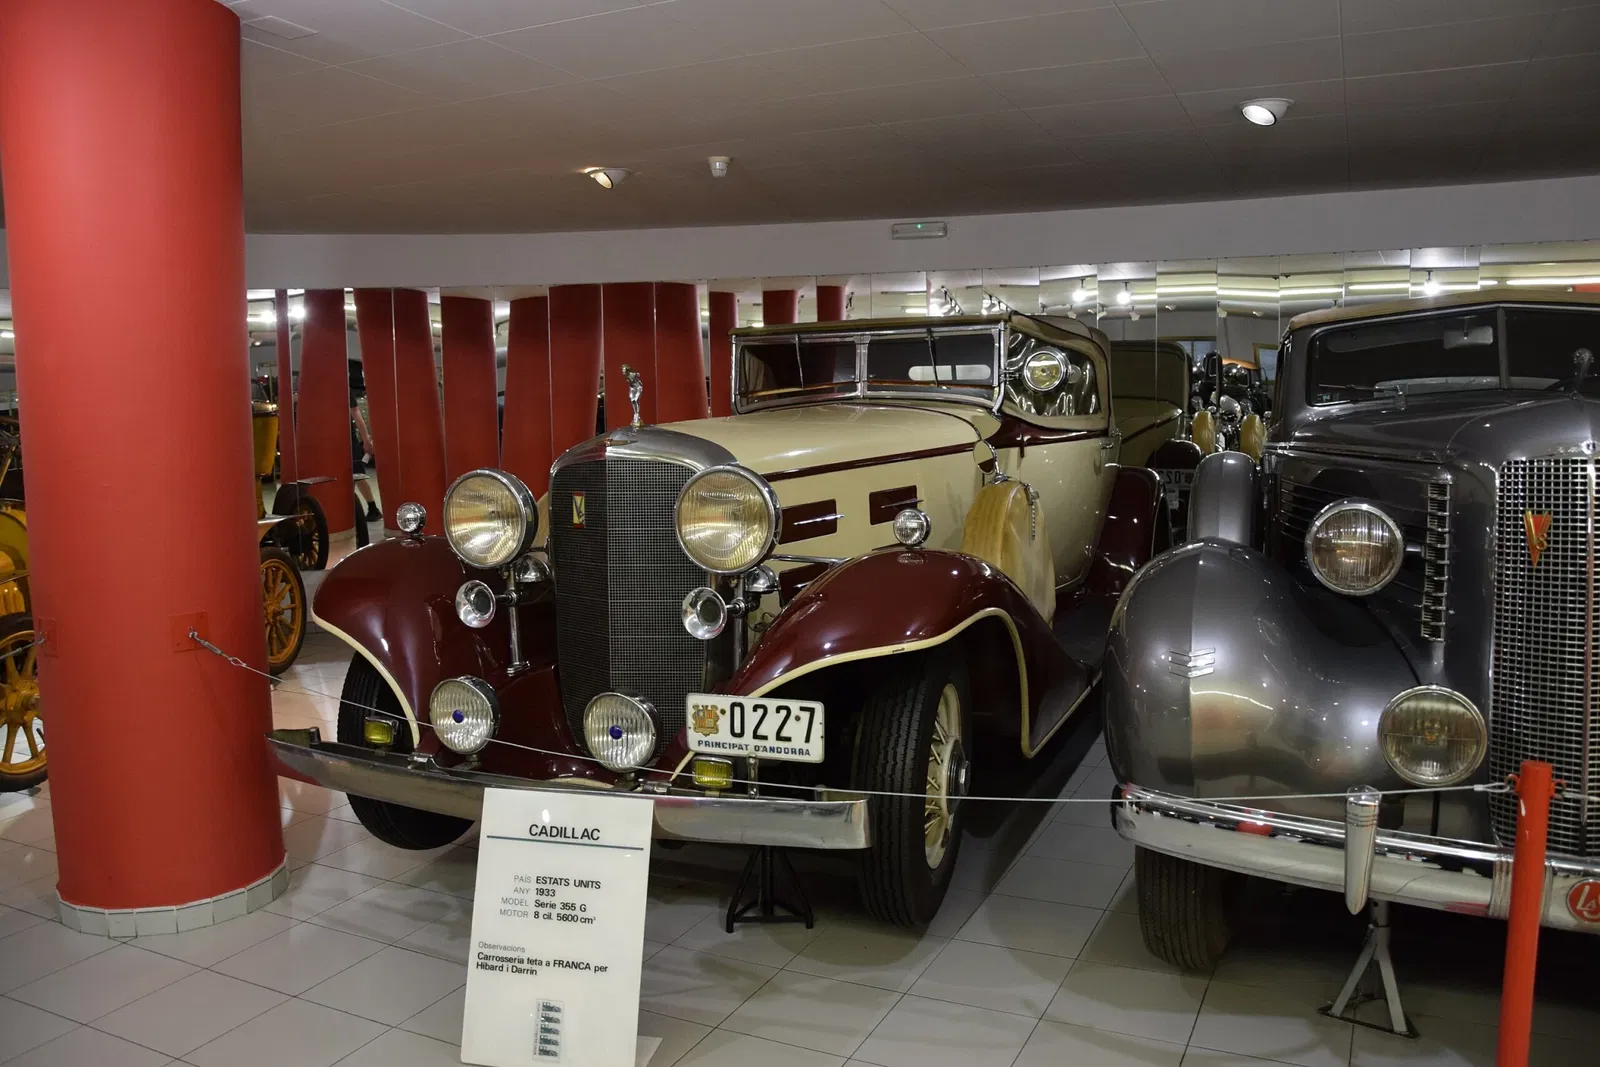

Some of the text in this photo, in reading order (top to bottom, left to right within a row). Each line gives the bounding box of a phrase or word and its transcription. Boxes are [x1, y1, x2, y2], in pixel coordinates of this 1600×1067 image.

[730, 702, 815, 743] 0227
[697, 739, 811, 757] PRINCIPAT D'ANDORRA
[529, 824, 600, 841] CADILLAC
[536, 875, 570, 887] ESTATS
[573, 879, 602, 890] UNITS
[513, 887, 556, 897] ANY 1933
[501, 897, 587, 913] MODEL Serie 355 G
[499, 908, 529, 919] MOTOR
[533, 911, 540, 920] 8
[556, 912, 579, 923] 5600
[478, 941, 526, 953] Observacions
[476, 961, 504, 972] Hibard
[510, 964, 538, 976] Darrin
[477, 951, 525, 965] Carrosseria
[526, 956, 543, 967] feta
[593, 964, 608, 974] per
